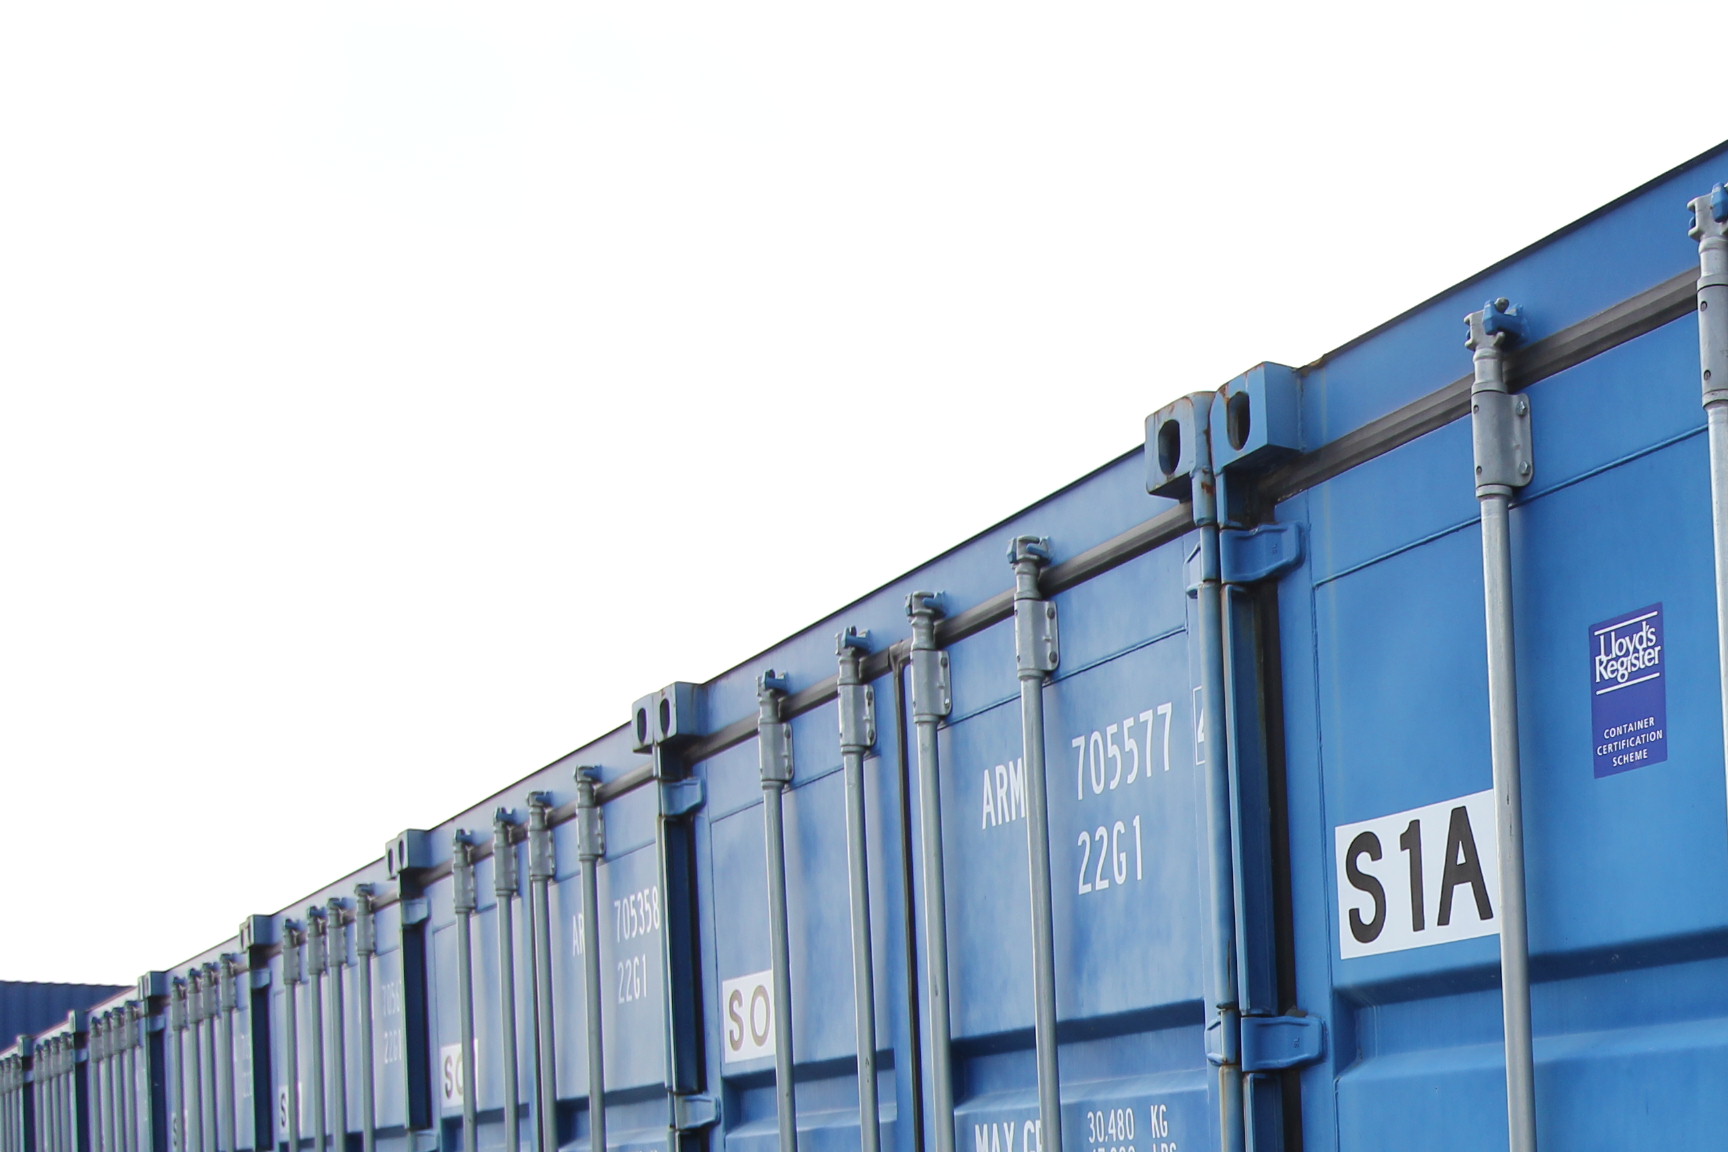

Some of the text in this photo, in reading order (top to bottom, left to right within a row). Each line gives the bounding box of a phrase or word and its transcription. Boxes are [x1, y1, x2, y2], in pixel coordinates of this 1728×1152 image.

[1599, 621, 1656, 662] Lloyd's
[1595, 646, 1661, 683] Register
[1597, 729, 1663, 756] CERTIFICATION
[1603, 716, 1655, 739] CONTAINER
[1072, 702, 1171, 800] 705577
[1612, 748, 1648, 767] SCHEME
[1078, 815, 1141, 894] 22G1
[1345, 805, 1494, 945] S1A
[619, 954, 646, 1001] 22G1
[1088, 1105, 1167, 1143] 30,480 KG
